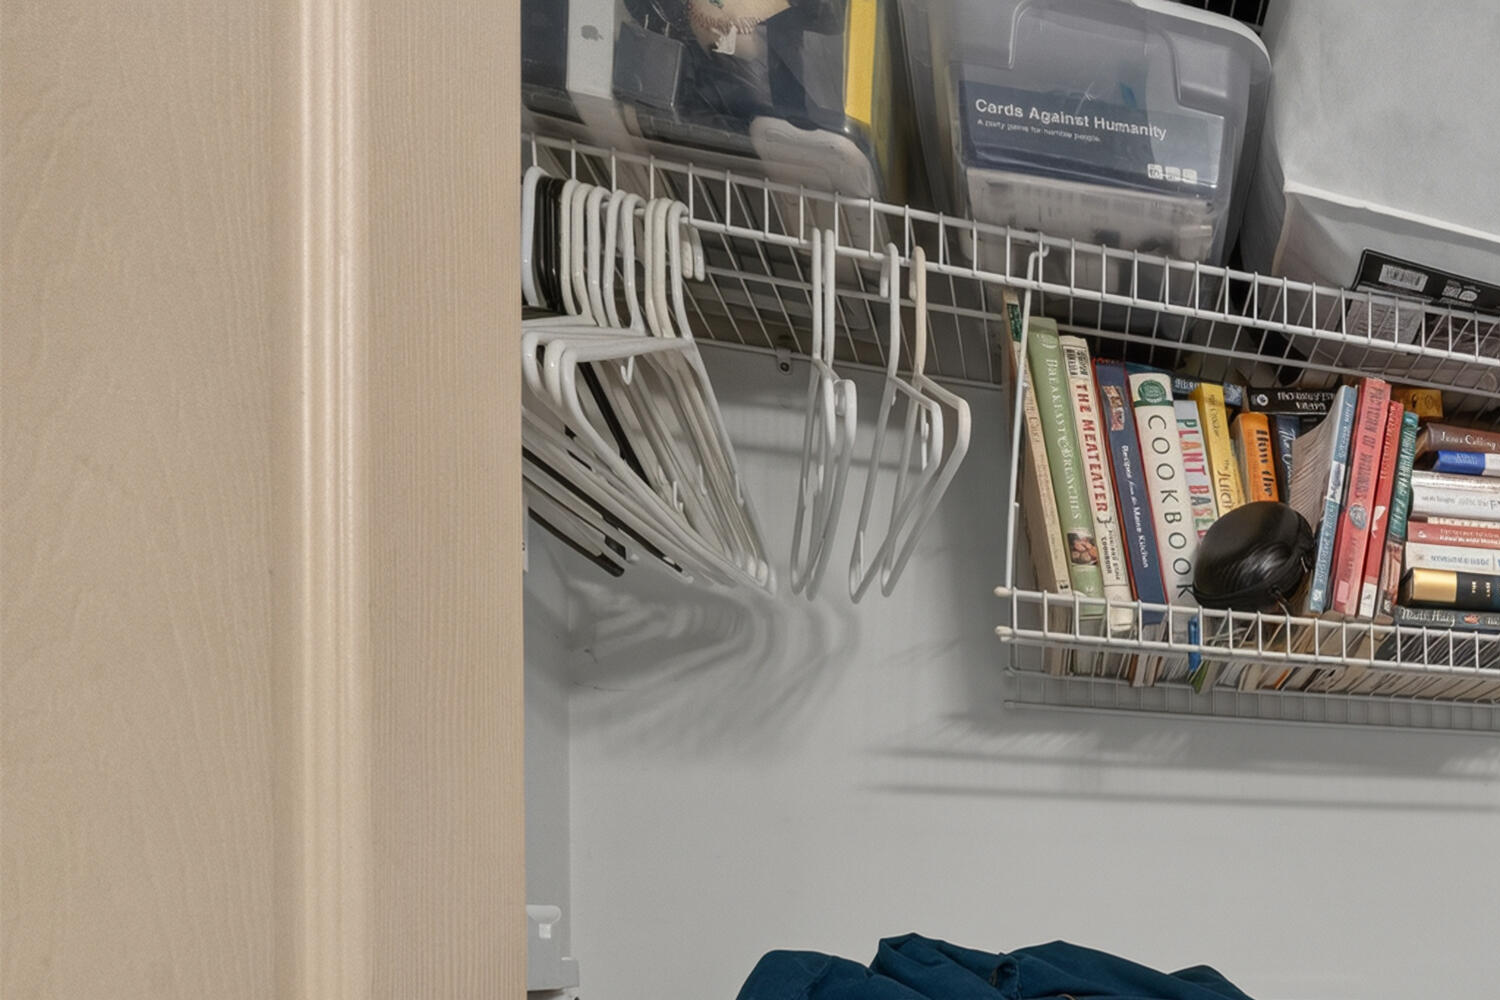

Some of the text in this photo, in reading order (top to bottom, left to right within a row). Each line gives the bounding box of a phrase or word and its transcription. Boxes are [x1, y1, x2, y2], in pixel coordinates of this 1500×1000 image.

[975, 98, 1168, 141] Cards Against Humanity
[976, 118, 984, 126] A
[985, 120, 1006, 130] party
[1076, 384, 1108, 512] THE MEATEATER
[1176, 418, 1207, 476] PLANT
[1256, 428, 1270, 464] How
[1148, 415, 1194, 599] COOKBOOK
